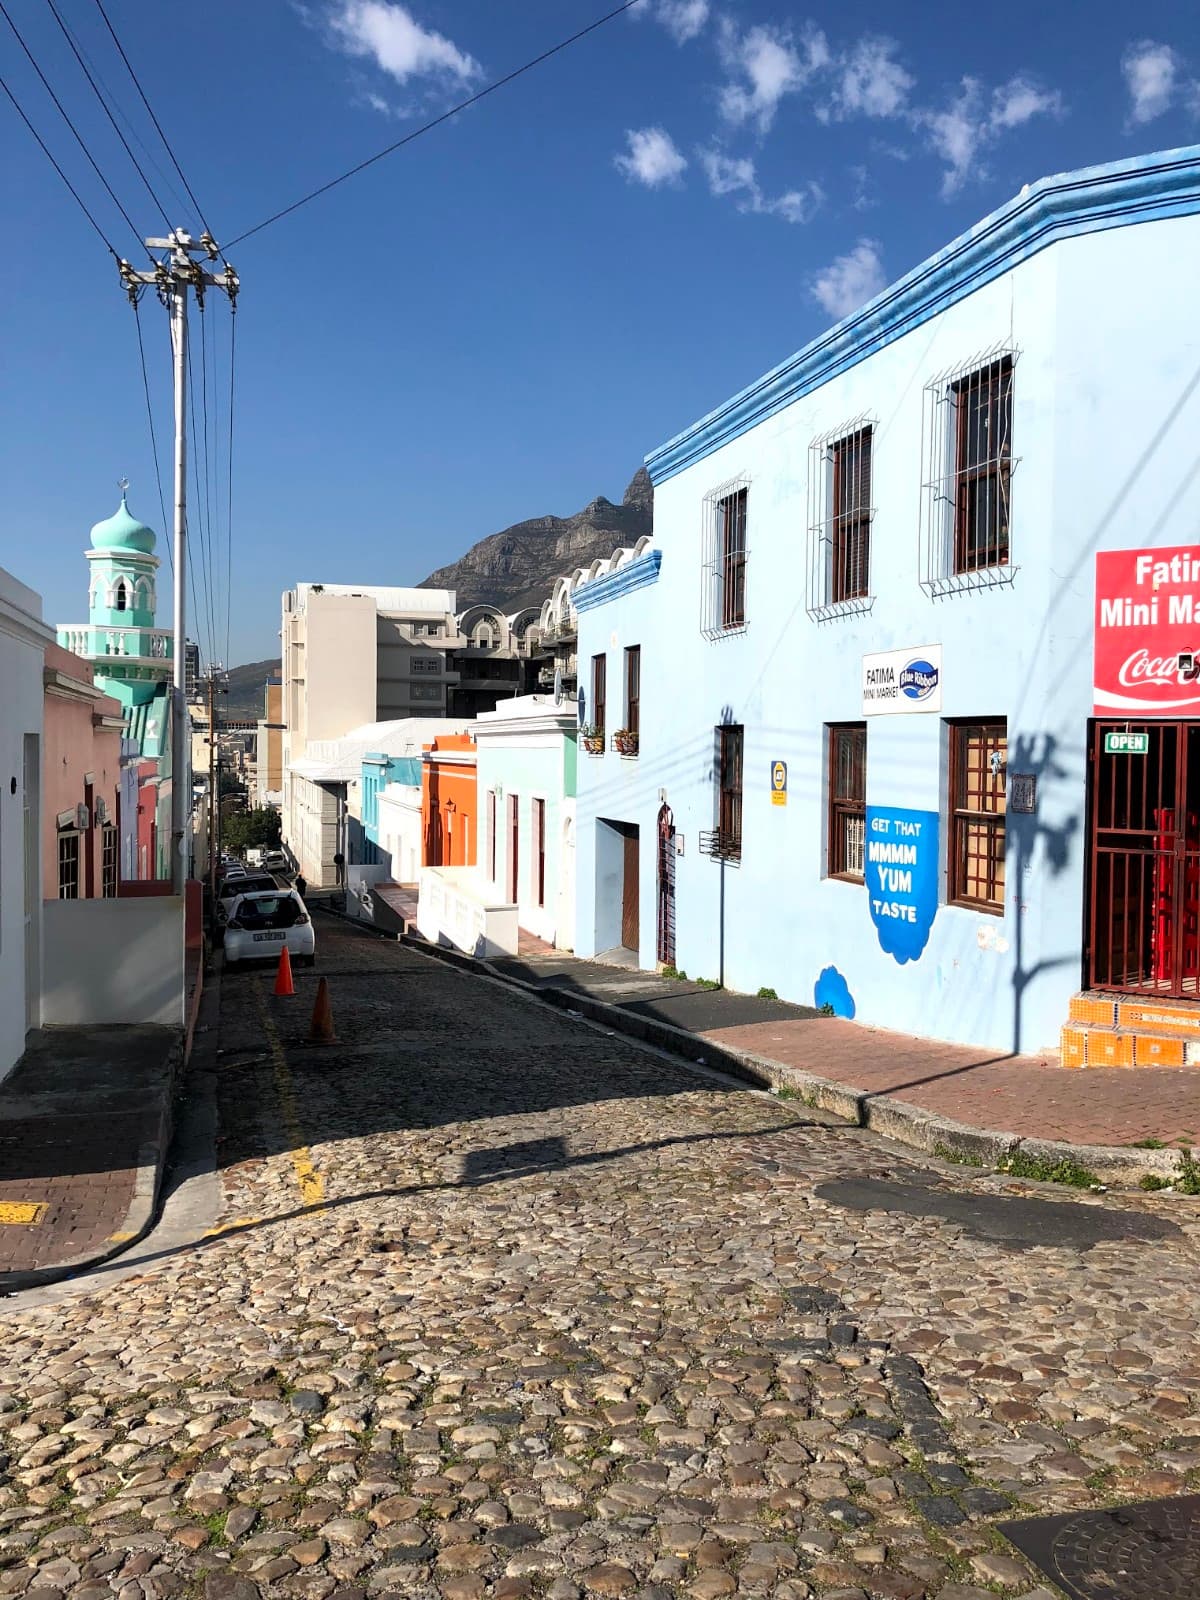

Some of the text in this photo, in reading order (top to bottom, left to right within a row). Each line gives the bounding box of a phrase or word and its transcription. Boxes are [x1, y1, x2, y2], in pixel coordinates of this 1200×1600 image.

[1136, 553, 1200, 585] Fati
[1100, 597, 1159, 628] Mini
[866, 666, 895, 685] FATIMA
[863, 685, 899, 700] MINI MARKET
[1110, 735, 1143, 750] OPEN
[871, 817, 921, 837] GET THAT
[869, 841, 917, 865] MMMM
[878, 865, 912, 893] YUM
[872, 899, 917, 923] TASTE
